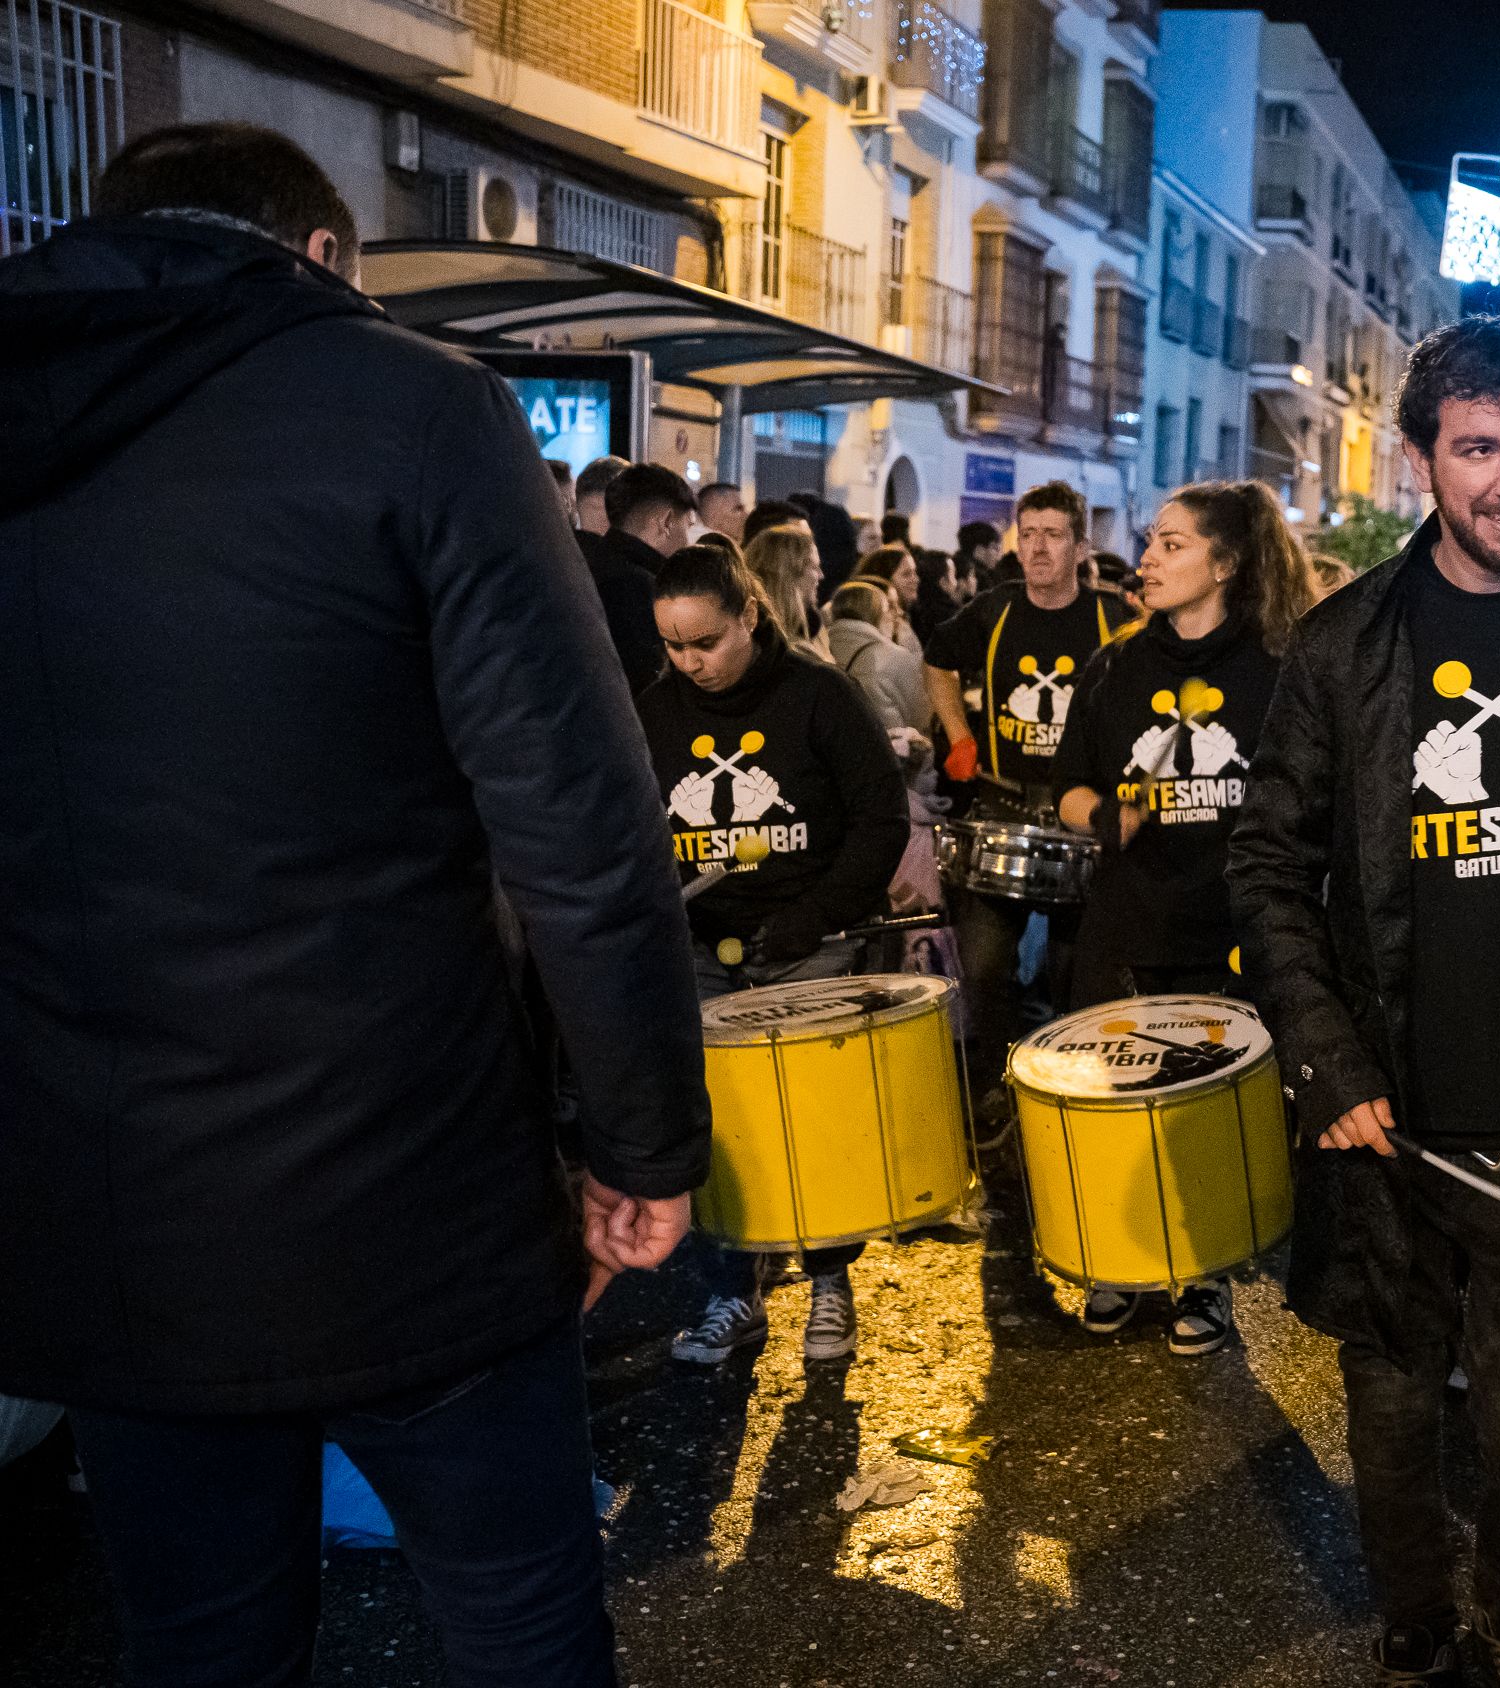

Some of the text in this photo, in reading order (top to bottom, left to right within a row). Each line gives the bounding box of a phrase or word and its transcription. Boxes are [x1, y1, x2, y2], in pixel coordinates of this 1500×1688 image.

[519, 397, 597, 434] ATE
[998, 715, 1065, 746] ARTESA
[1160, 808, 1219, 825] BATUCADA
[1146, 1018, 1232, 1030] BATUCADA
